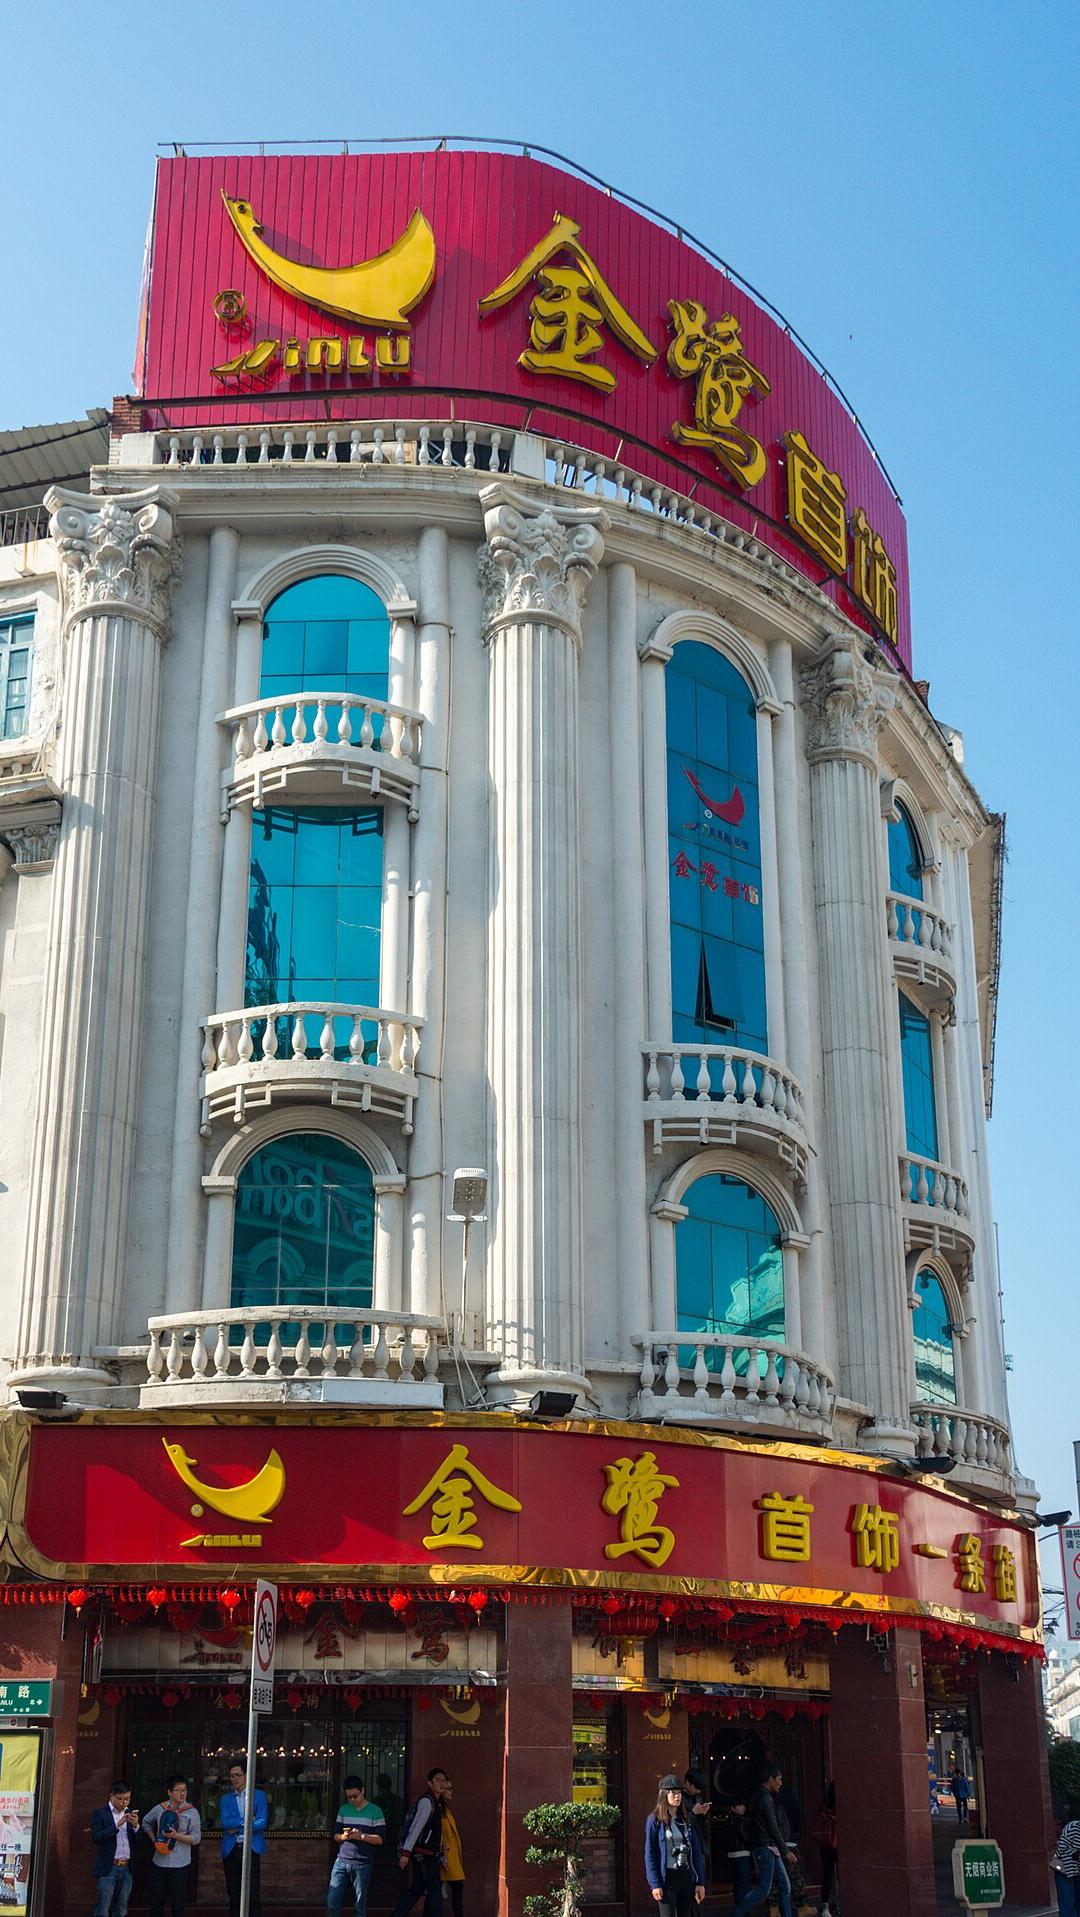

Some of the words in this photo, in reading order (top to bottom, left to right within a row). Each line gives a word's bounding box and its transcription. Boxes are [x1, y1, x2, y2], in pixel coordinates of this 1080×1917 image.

[965, 1861, 999, 1877] 无烟商业街
